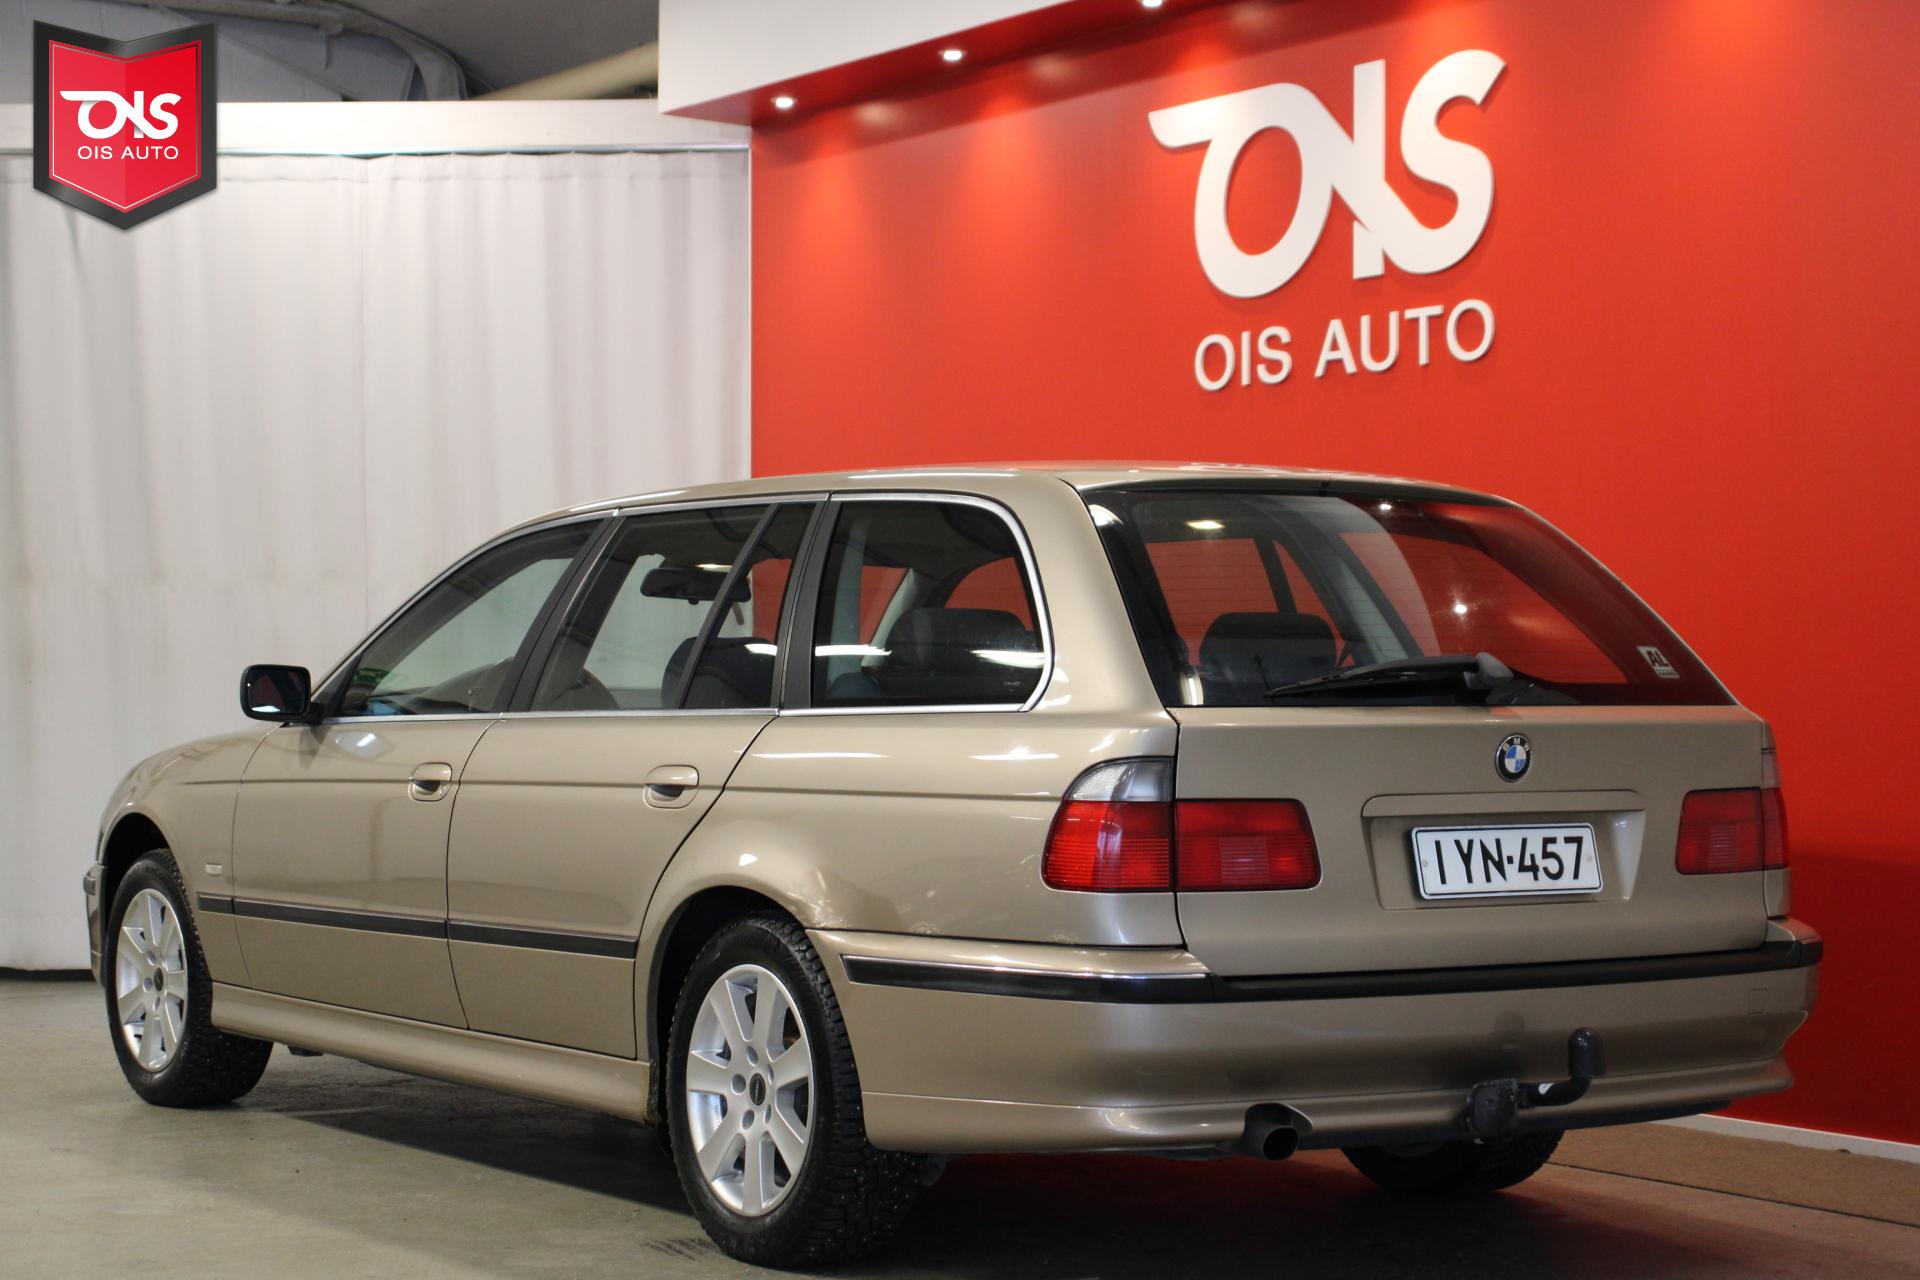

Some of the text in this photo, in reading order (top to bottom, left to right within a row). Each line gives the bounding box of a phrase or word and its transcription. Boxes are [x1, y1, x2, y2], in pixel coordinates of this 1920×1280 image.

[1149, 49, 1505, 298] OIS
[1195, 299, 1495, 391] OIS AUTO
[1502, 737, 1530, 752] BMW
[1434, 836, 1584, 885] IYN-457
